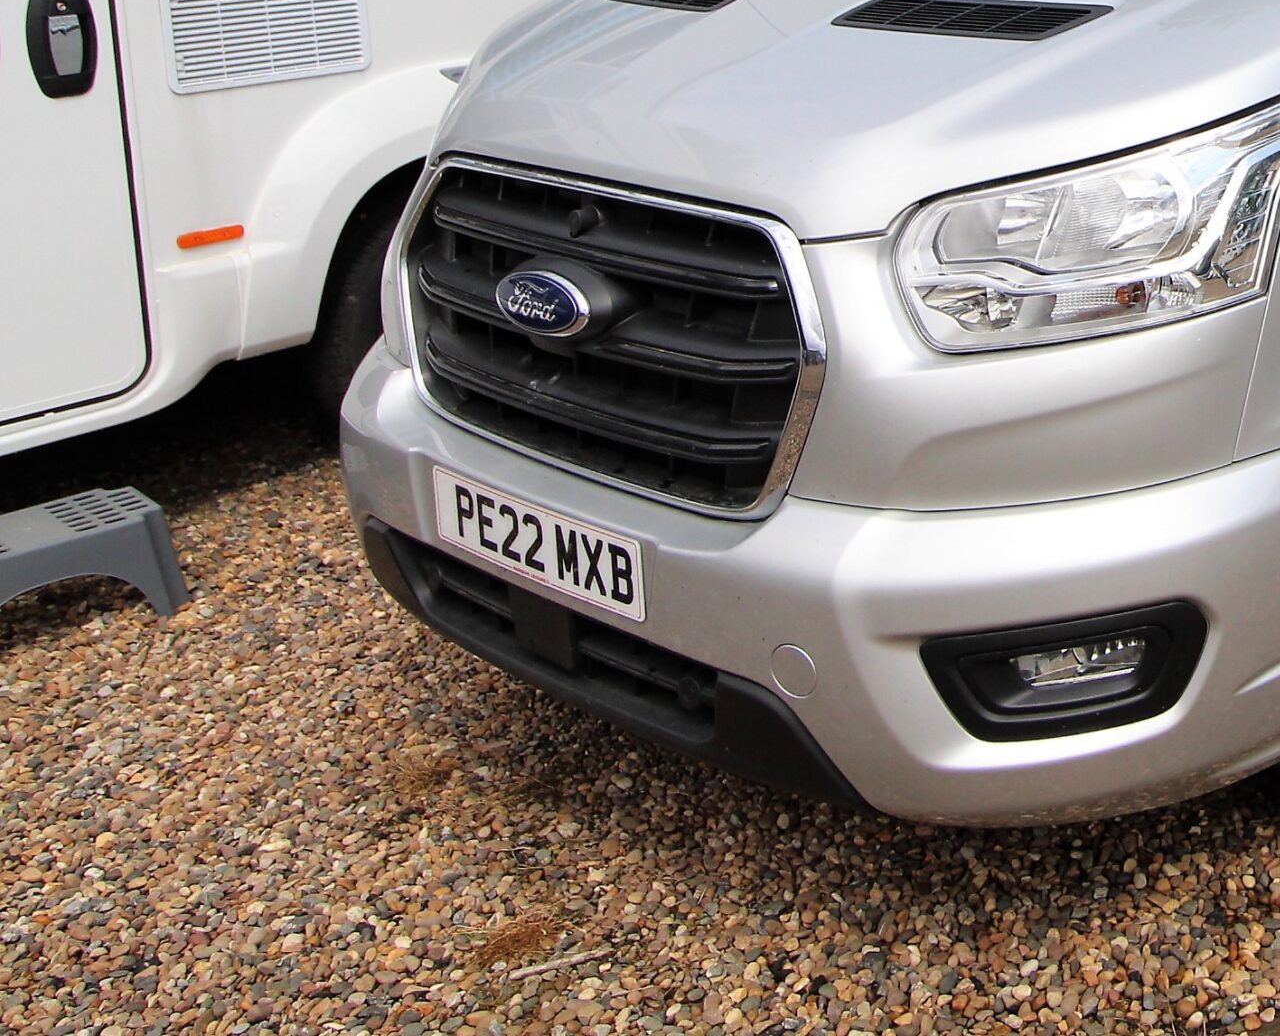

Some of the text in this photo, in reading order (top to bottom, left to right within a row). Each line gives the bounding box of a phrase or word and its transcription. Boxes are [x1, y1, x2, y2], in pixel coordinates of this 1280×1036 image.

[507, 280, 558, 322] Ford
[454, 483, 635, 606] PE22 MXB
